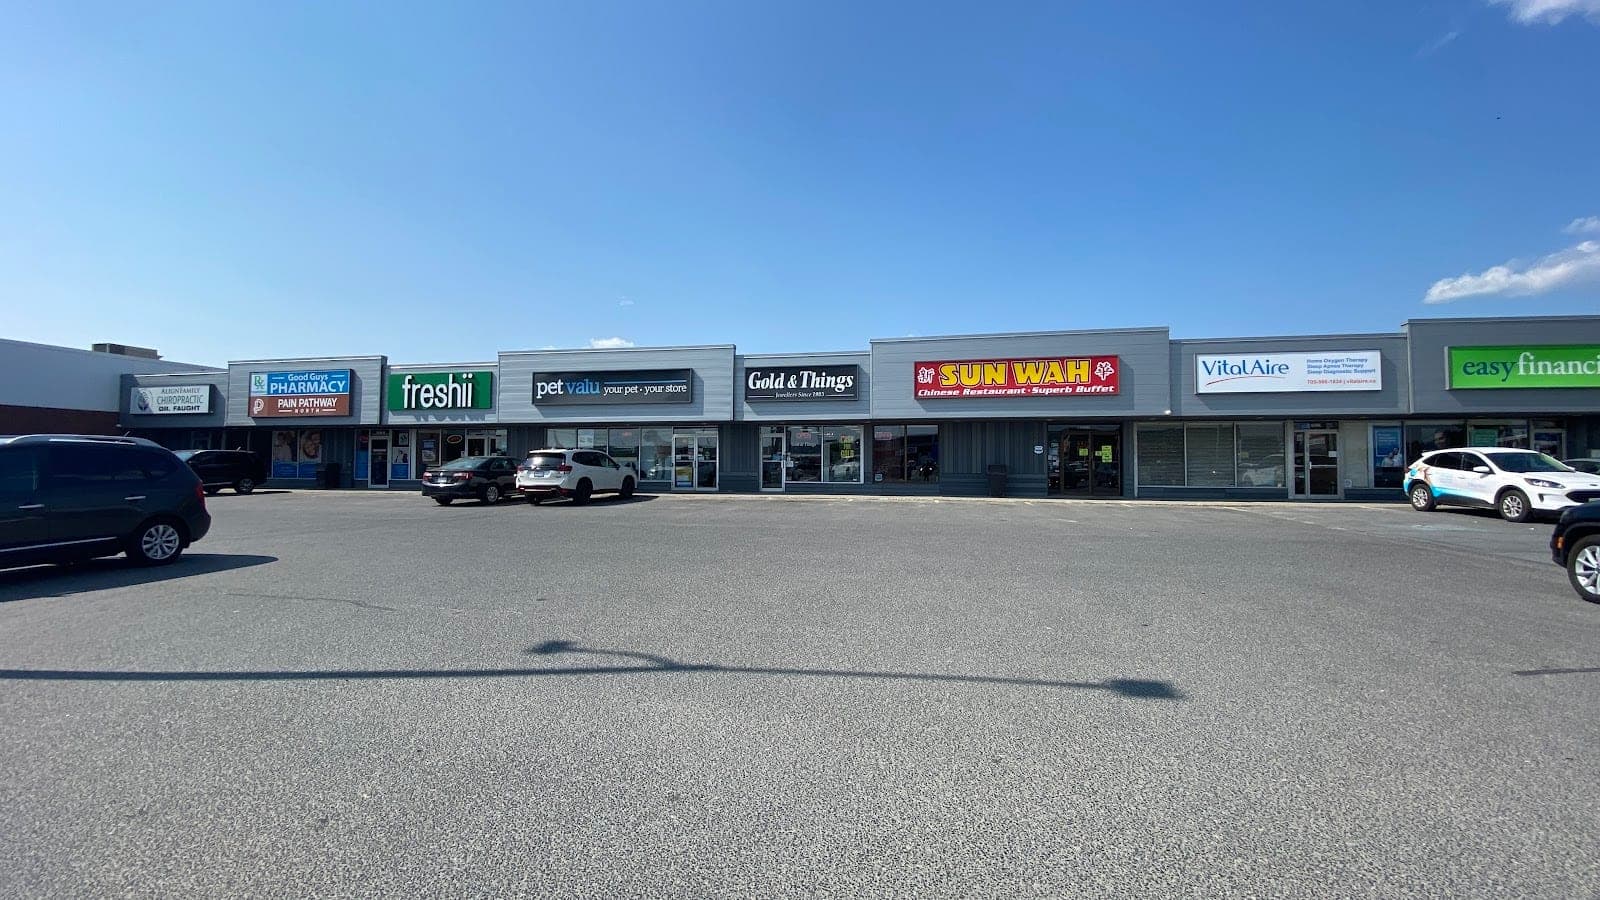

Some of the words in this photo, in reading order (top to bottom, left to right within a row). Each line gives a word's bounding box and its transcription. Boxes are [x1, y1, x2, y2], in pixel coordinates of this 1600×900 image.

[939, 362, 1007, 388] SUN
[1011, 359, 1091, 386] WAH
[1202, 359, 1289, 375] VitalAire
[287, 373, 308, 381] Good
[309, 372, 329, 381] Guys
[748, 371, 785, 389] Gold
[787, 374, 798, 389] &
[799, 370, 854, 393] Things
[270, 381, 346, 394] PHARMACY
[402, 373, 473, 409] freshii
[536, 379, 564, 399] pet
[565, 378, 600, 395] valu
[603, 386, 624, 396] your
[624, 385, 638, 396] pet
[644, 385, 664, 395] your
[665, 383, 688, 393] store
[918, 389, 960, 397] Chinese
[963, 387, 1027, 396] Restaurant
[1031, 386, 1072, 395] Superb
[1076, 385, 1115, 393] Buffet
[156, 394, 204, 405] CHIROPRACTIC
[278, 398, 297, 408] PAIN
[299, 397, 338, 408] PATHWAY
